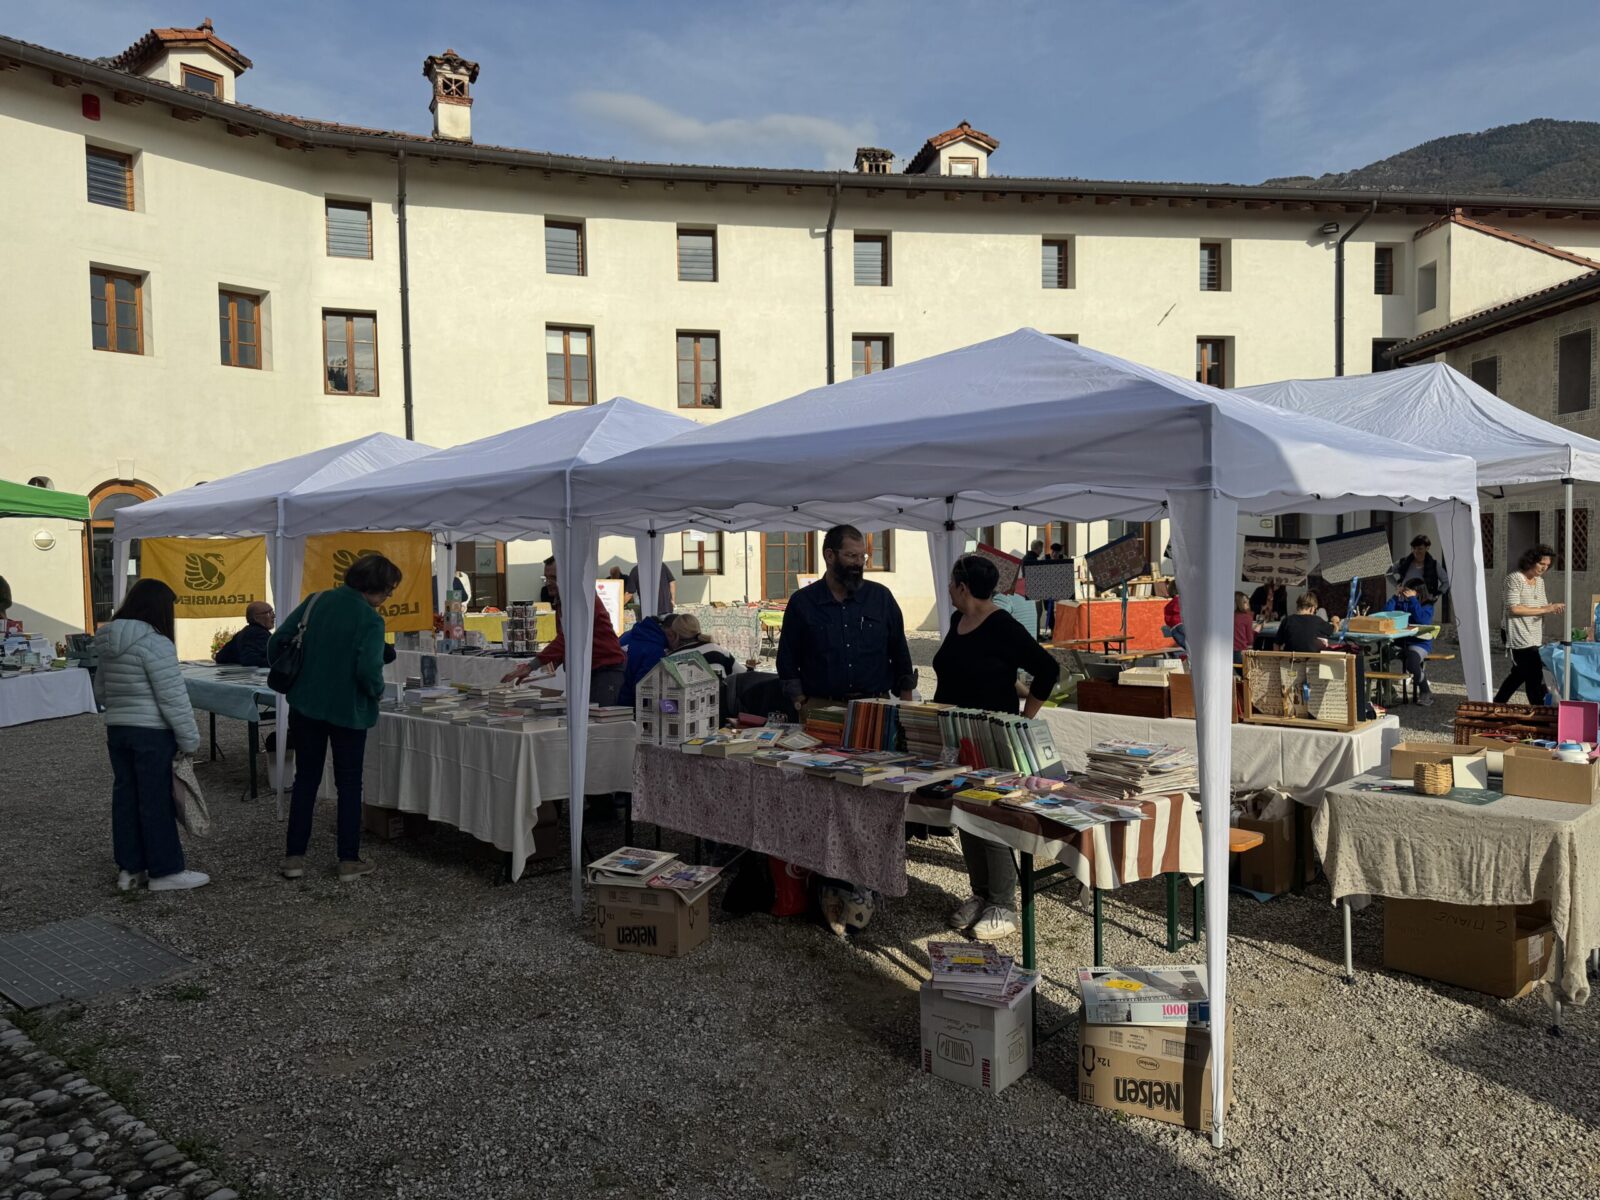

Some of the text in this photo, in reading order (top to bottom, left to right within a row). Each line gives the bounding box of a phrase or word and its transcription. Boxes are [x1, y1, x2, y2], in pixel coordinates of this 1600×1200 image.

[617, 926, 657, 947] Nelsen
[1162, 1004, 1188, 1016] 1000
[1097, 1056, 1111, 1068] 12x
[982, 1058, 992, 1090] FRAGILE
[1114, 1078, 1182, 1112] Nelsen
